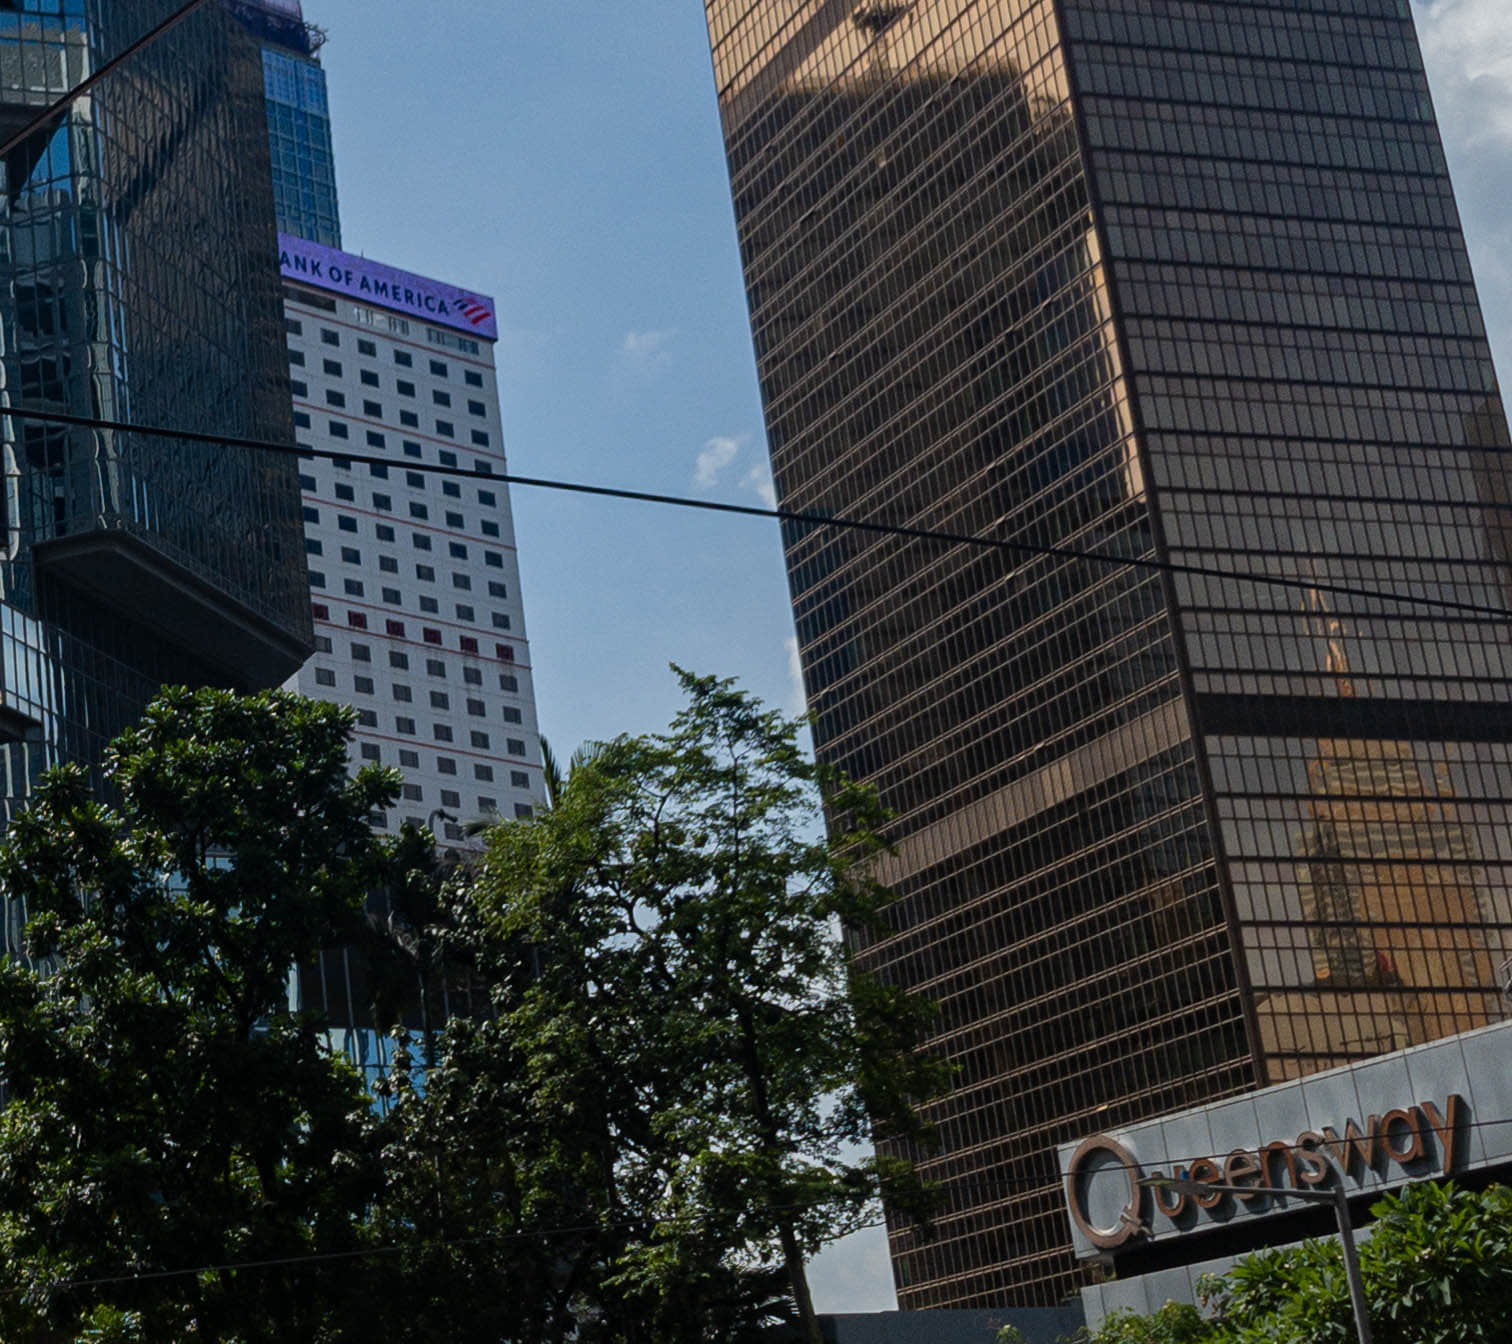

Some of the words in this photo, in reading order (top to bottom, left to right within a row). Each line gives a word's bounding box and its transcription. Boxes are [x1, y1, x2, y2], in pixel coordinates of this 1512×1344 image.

[279, 250, 322, 278] ANK
[328, 266, 353, 287] OF
[359, 275, 449, 317] AMERICA
[1067, 1094, 1470, 1249] Queensway
